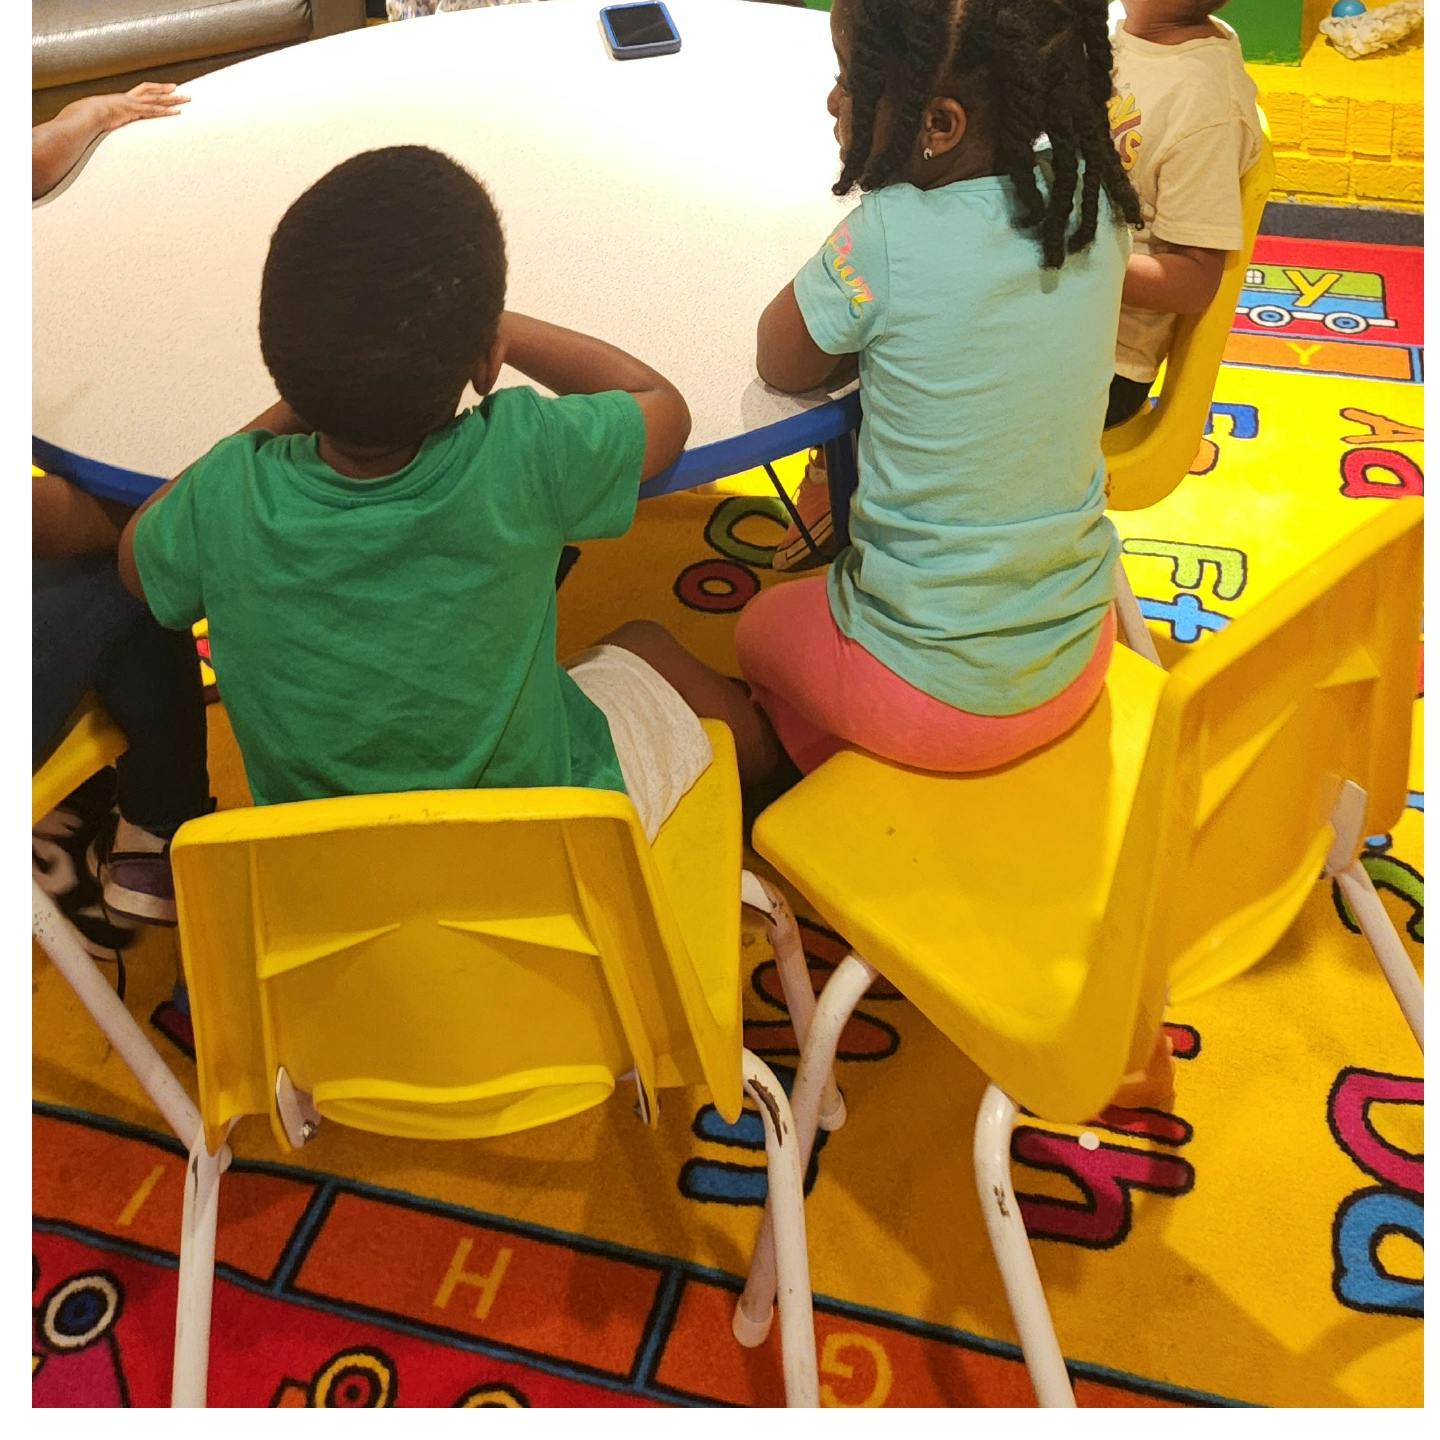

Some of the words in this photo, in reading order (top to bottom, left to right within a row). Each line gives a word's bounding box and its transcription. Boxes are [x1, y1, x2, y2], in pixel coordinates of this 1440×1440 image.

[1284, 268, 1343, 307] Y
[1286, 343, 1323, 366] Y
[433, 1237, 513, 1321] H
[819, 1331, 891, 1408] G
